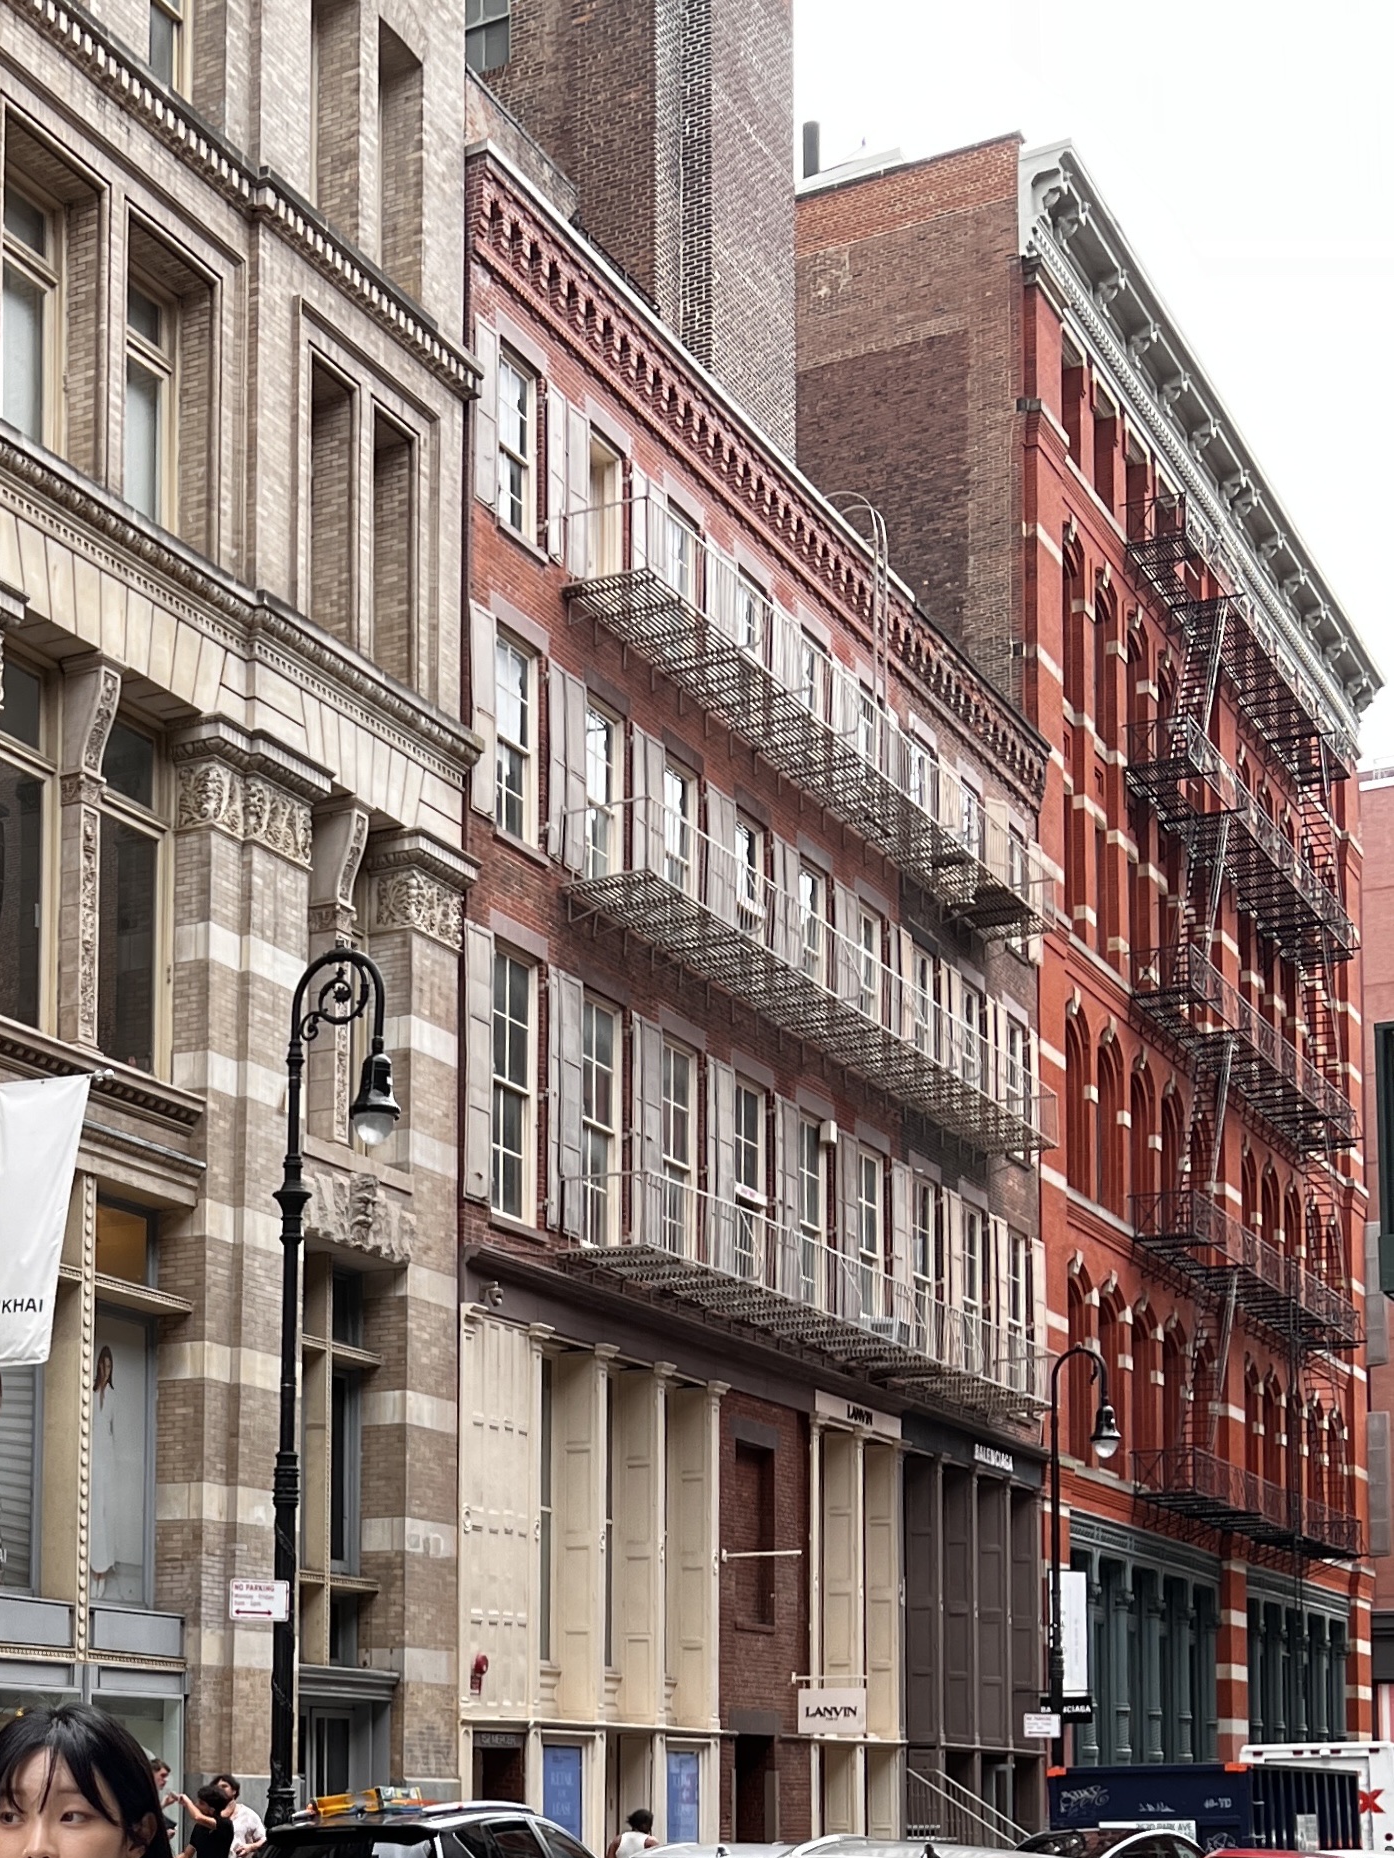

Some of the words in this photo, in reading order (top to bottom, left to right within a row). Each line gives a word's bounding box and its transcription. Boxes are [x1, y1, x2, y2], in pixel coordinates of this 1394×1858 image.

[847, 1404, 873, 1426] LANVIN
[246, 1584, 275, 1592] PARKING
[806, 1706, 857, 1717] LANVIN
